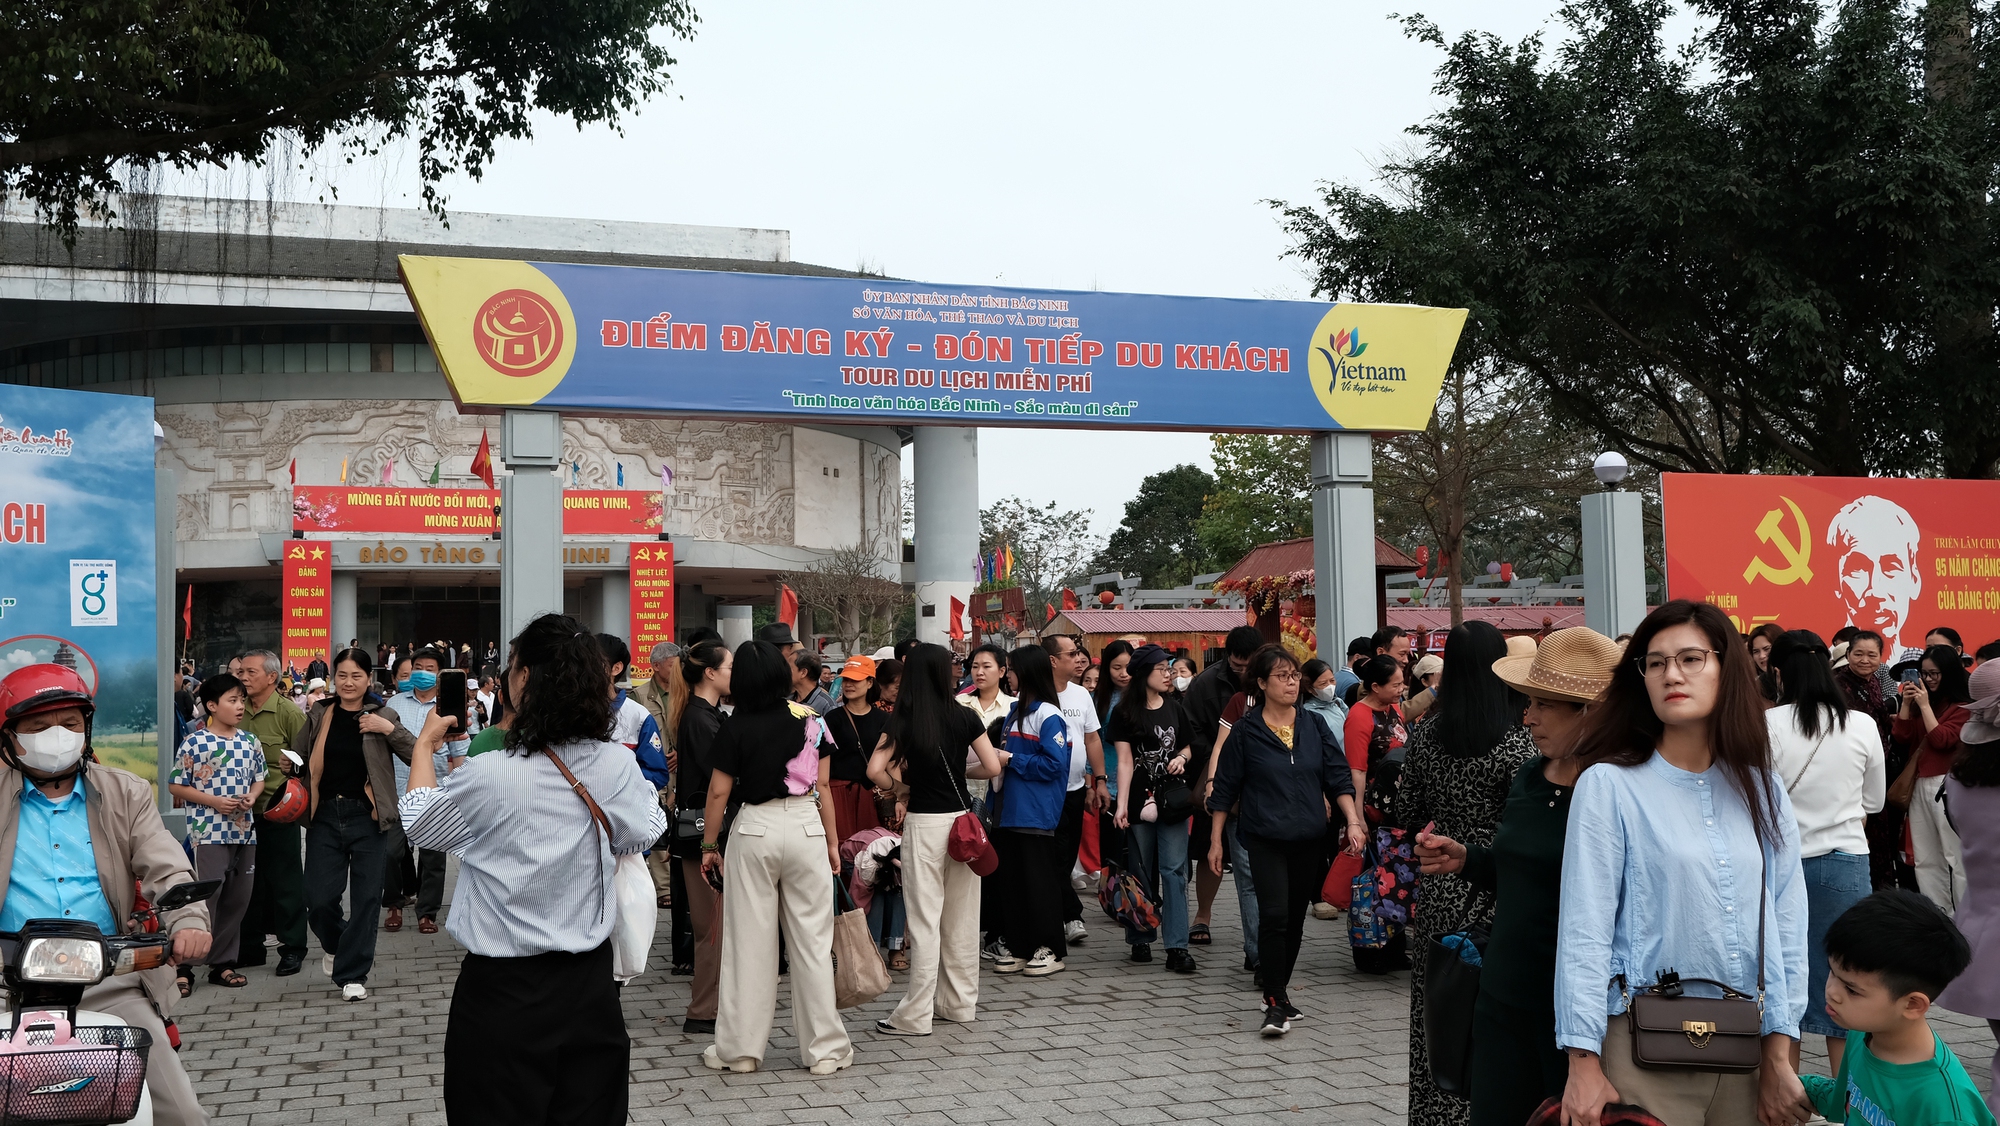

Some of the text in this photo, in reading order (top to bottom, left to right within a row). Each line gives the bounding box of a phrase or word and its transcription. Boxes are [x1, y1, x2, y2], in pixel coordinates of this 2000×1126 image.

[500, 297, 516, 306] NINH
[863, 288, 882, 302] ỦY
[884, 292, 911, 304] BAN
[912, 292, 948, 306] NHÂN
[951, 293, 977, 308] DÂN
[1038, 299, 1069, 311] NINH
[853, 307, 871, 319] SỞ
[874, 308, 902, 320] VĂN
[904, 309, 937, 323] HÓA,
[968, 313, 1003, 325] THAO
[1006, 313, 1025, 326] VÀ
[1027, 316, 1046, 326] DU
[1048, 316, 1079, 328] LỊCH
[601, 312, 707, 351] ĐIỂM
[720, 321, 831, 355] ĐĂNG
[845, 327, 894, 357] KÝ
[934, 331, 1012, 362] ĐÓN
[1024, 332, 1103, 365] TIẾP
[1116, 342, 1163, 368] DU
[1175, 341, 1290, 372] KHÁCH
[1315, 347, 1407, 395] Vietnam
[840, 366, 1092, 392] TOUR DU LỊCH MIỄN PHÍ
[830, 396, 860, 408] hoa
[864, 396, 892, 409] văn
[897, 397, 926, 410] hóa
[930, 396, 960, 411] Bắc
[964, 400, 1000, 412] Ninh
[1015, 398, 1044, 414] Sắc
[1048, 402, 1081, 415] màu
[1084, 402, 1099, 415] di
[22, 427, 53, 445] Quan
[54, 430, 73, 449] Họ
[347, 491, 382, 506] MỪNG
[385, 491, 407, 507] ĐẤT
[410, 493, 441, 508] NƯỚC
[444, 492, 463, 508] ĐỔI
[466, 494, 491, 509] MỚI,
[563, 497, 631, 510] QUANG VINH,
[0, 502, 46, 544] CH
[424, 514, 458, 528] MỪNG
[462, 514, 492, 528] XUÂN
[1960, 536, 1978, 548] LÃM
[360, 540, 408, 563] BẢO
[420, 542, 485, 563] TÀNG
[298, 565, 317, 577] ĐẢNG
[1935, 557, 1947, 577] 95
[1948, 553, 1970, 577] NĂM
[637, 568, 667, 578] NHIỆT LIỆT
[652, 579, 670, 587] MỪNG
[291, 585, 324, 598] CỘNG SẢN
[650, 590, 664, 598] NĂM
[1937, 584, 1956, 610] CỦA
[1958, 584, 1982, 610] ĐẢNG
[1717, 592, 1738, 611] NIỆM
[292, 606, 323, 618] VIỆT NAM
[636, 612, 669, 621] THÀNH LẬP
[287, 628, 327, 637] QUANG VINH
[644, 622, 660, 631] ĐẢNG
[637, 633, 668, 643] CỘNG SẢN
[288, 647, 309, 657] MUÔN
[638, 643, 651, 653] VIỆT
[35, 685, 64, 694] HONDA
[1063, 709, 1081, 717] POLO
